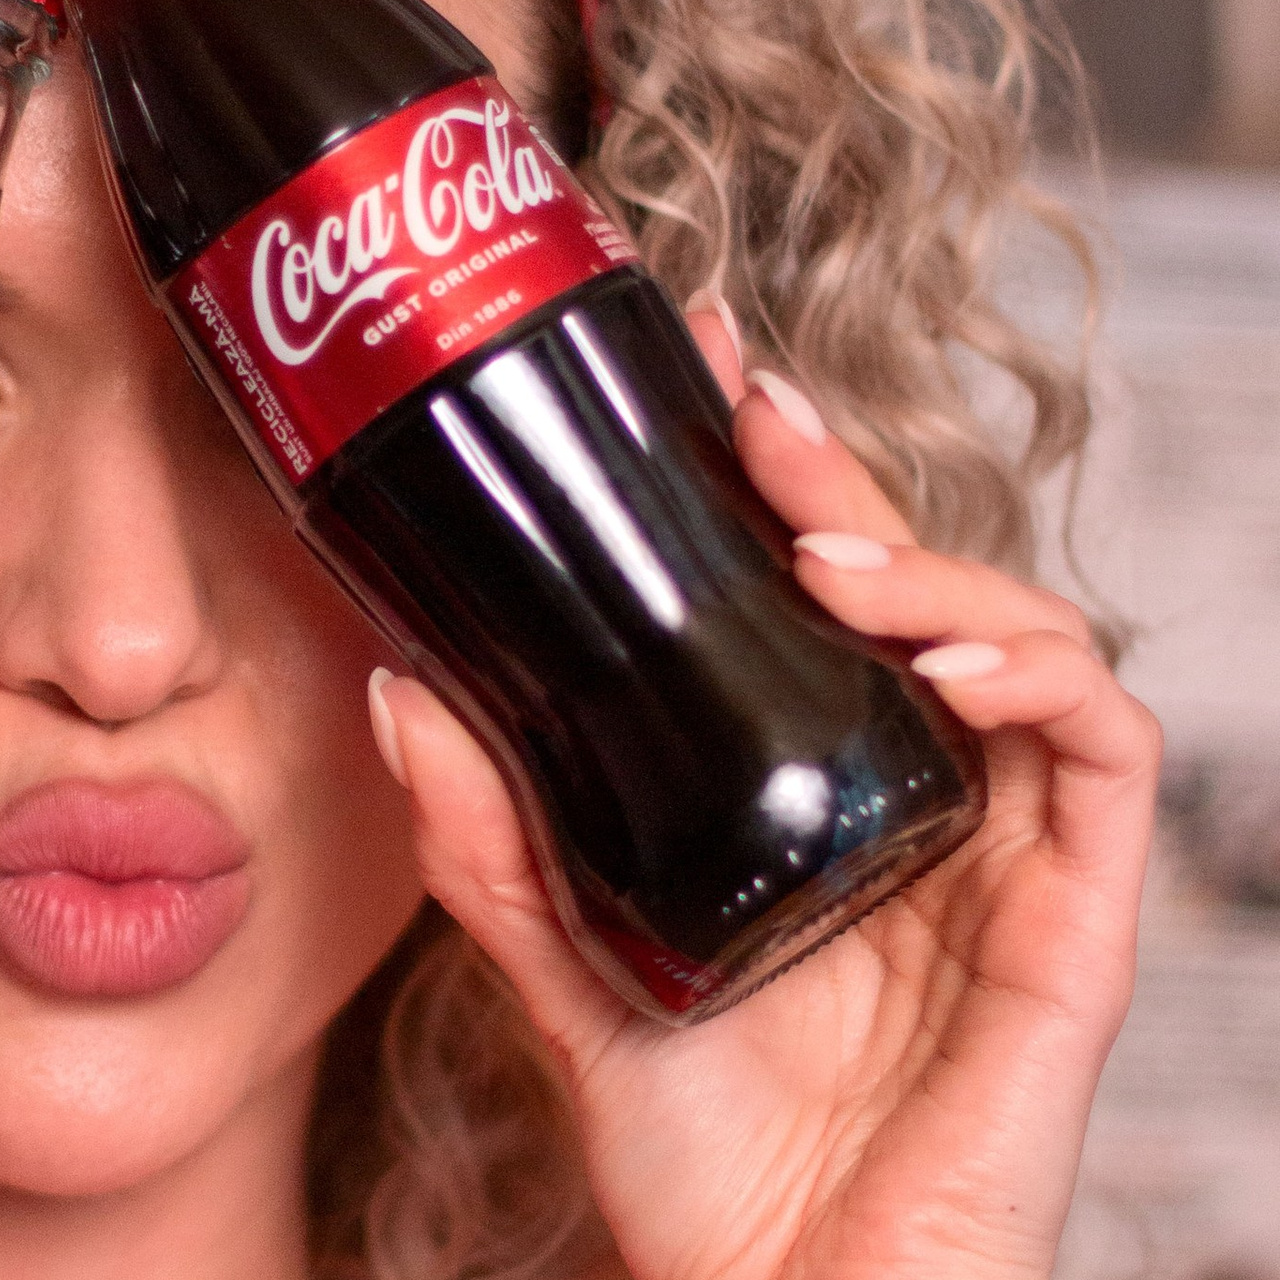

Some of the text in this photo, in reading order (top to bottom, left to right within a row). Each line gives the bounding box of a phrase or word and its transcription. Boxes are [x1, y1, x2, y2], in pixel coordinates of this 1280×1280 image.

[251, 99, 554, 366] Coca-Cola
[198, 280, 237, 340] RECICLABIL
[362, 227, 539, 347] GUST ORIGINAL
[435, 288, 523, 352] Din 1886
